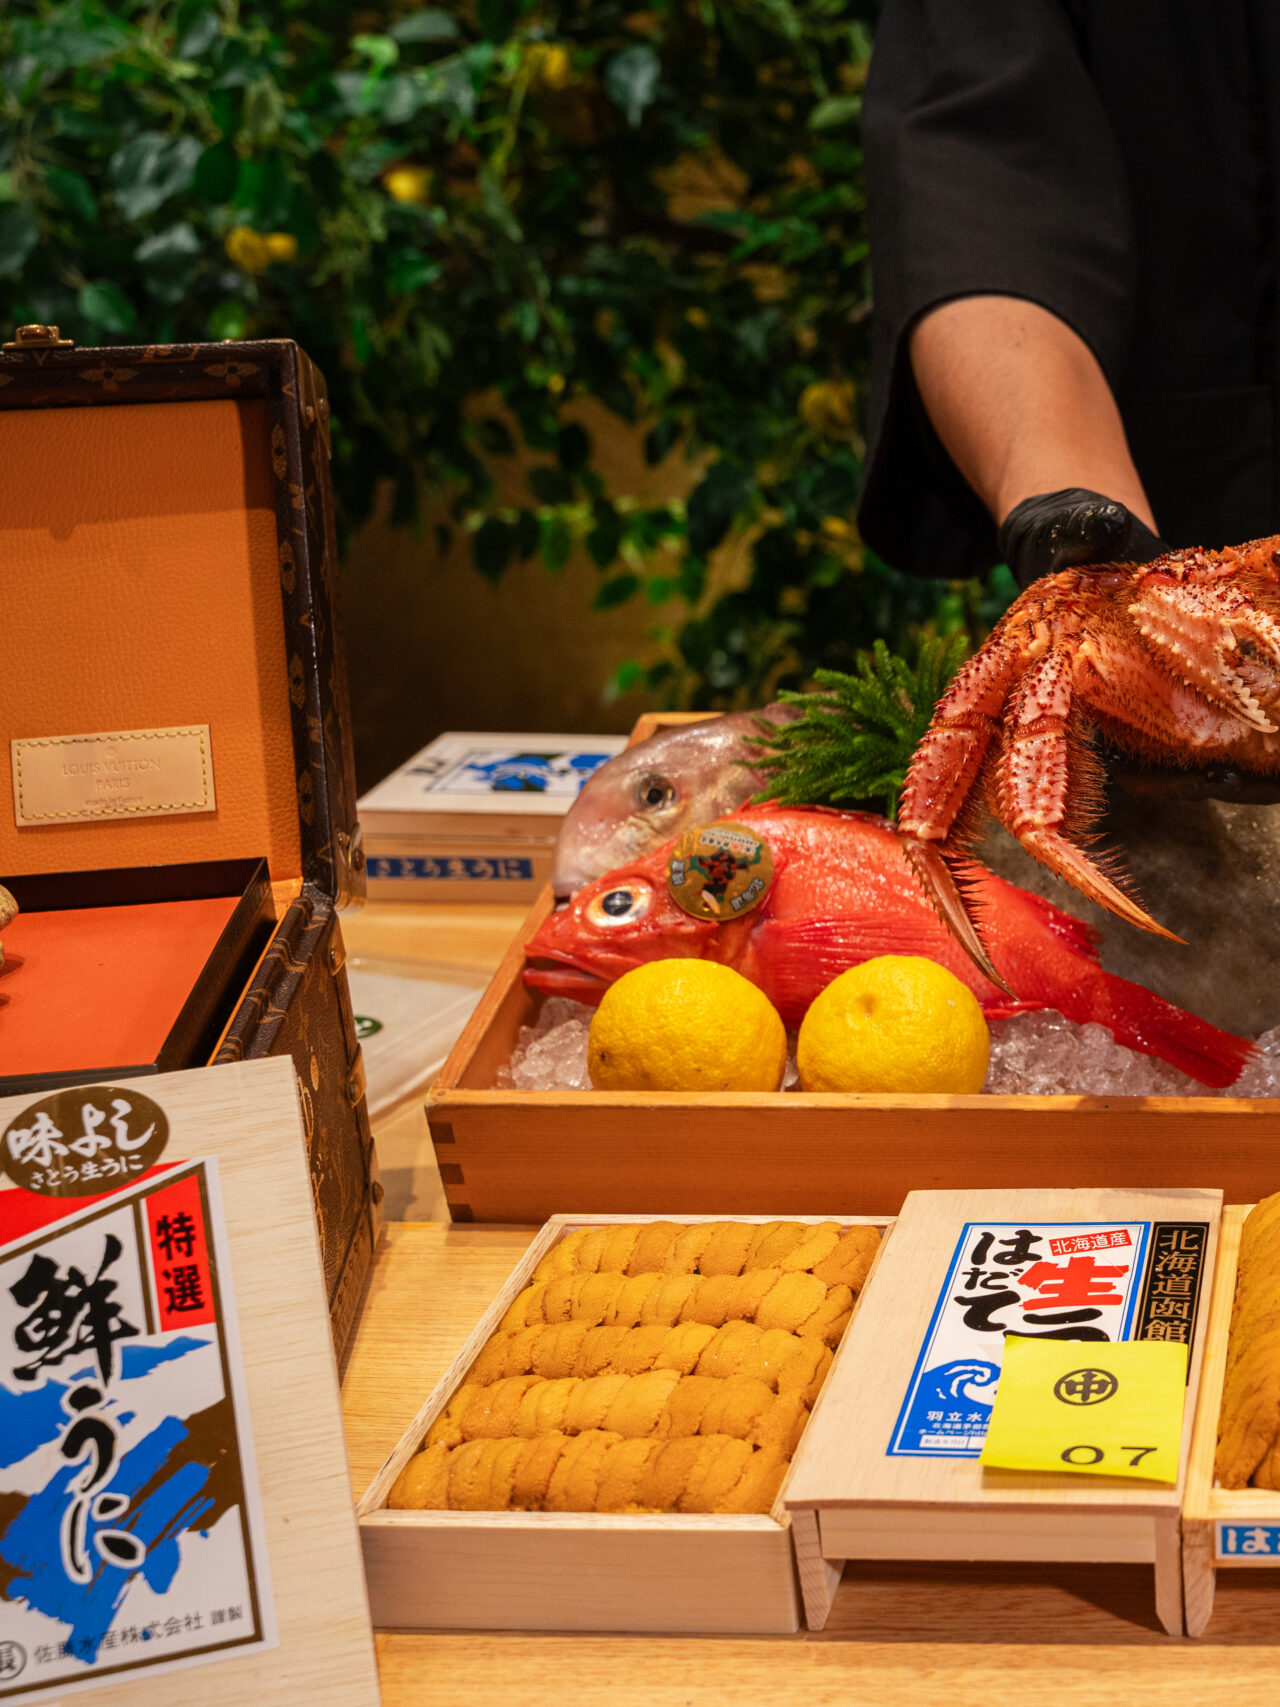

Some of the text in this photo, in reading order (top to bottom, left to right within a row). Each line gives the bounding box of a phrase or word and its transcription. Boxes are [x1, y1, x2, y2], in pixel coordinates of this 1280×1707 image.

[62, 758, 161, 776] LOUIS VUITTON
[96, 777, 131, 791] PARIS
[7, 1098, 156, 1167] 味よし
[30, 1154, 144, 1190] さとう生うに
[1052, 1231, 1129, 1255] 北海道産
[155, 1211, 205, 1314] 特選
[953, 1229, 1043, 1332] はだて
[1144, 1229, 1200, 1344] 北海道函館
[926, 1410, 991, 1423] 羽立水
[1060, 1445, 1159, 1467] 07
[34, 1611, 205, 1665] 佐藤水産株式会社
